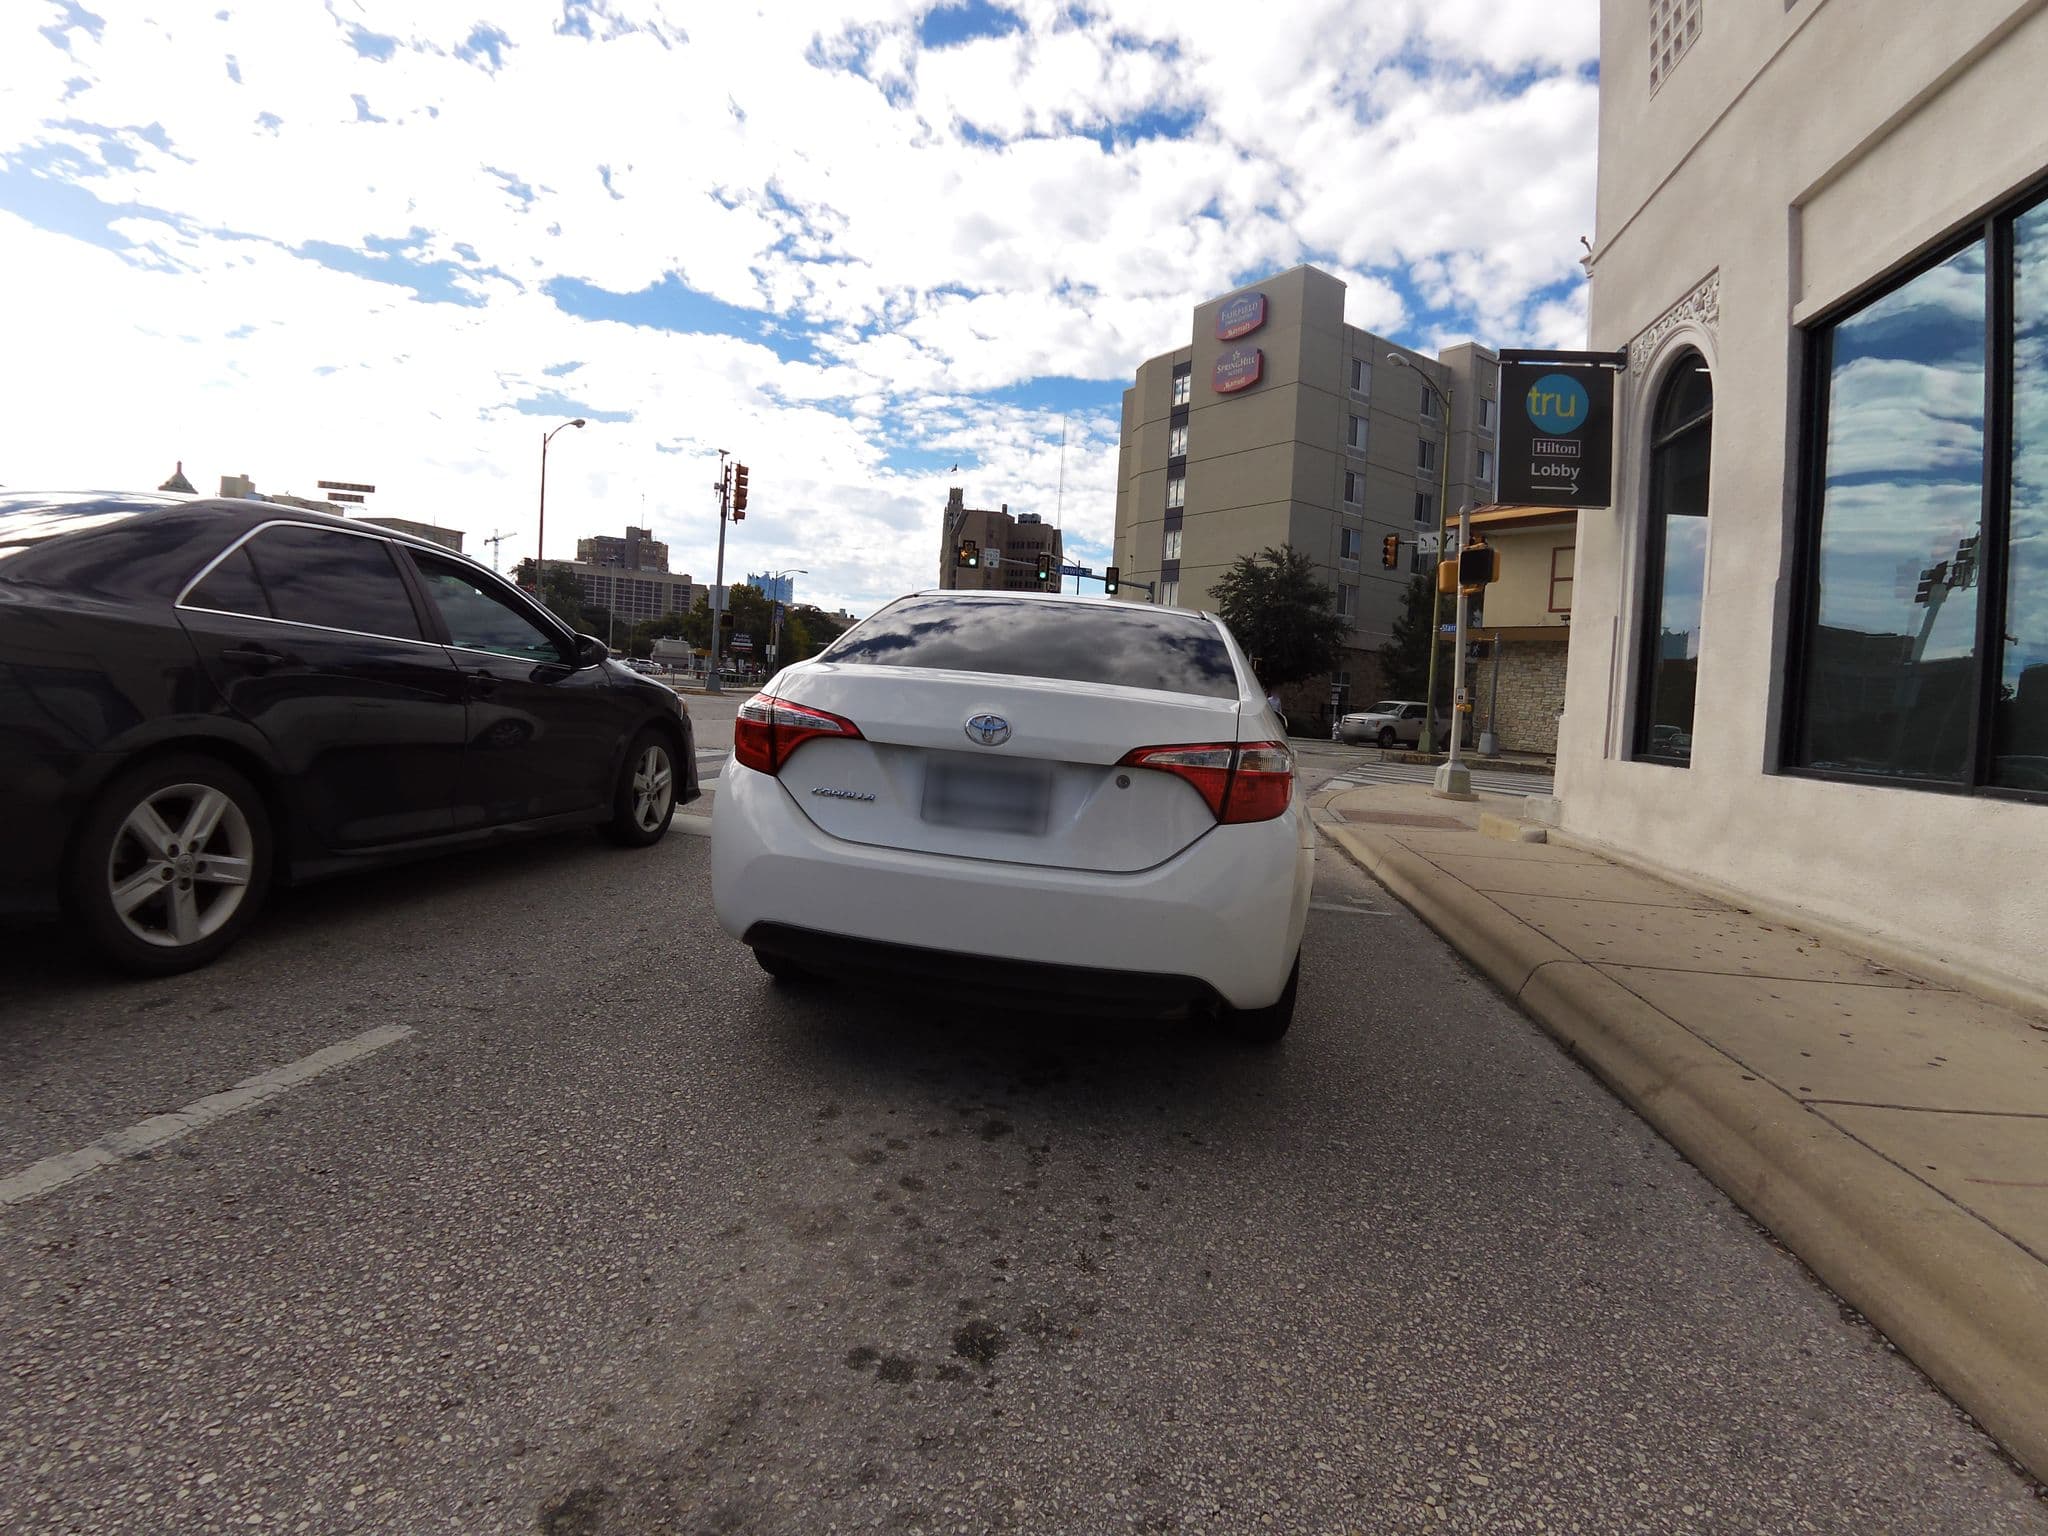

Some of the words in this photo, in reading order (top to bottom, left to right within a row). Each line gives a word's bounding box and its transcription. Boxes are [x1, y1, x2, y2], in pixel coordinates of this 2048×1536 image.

[1528, 386, 1576, 417] tru
[1536, 442, 1576, 455] Hilton
[1531, 462, 1580, 480] Lobby
[1059, 565, 1083, 576] Bowie
